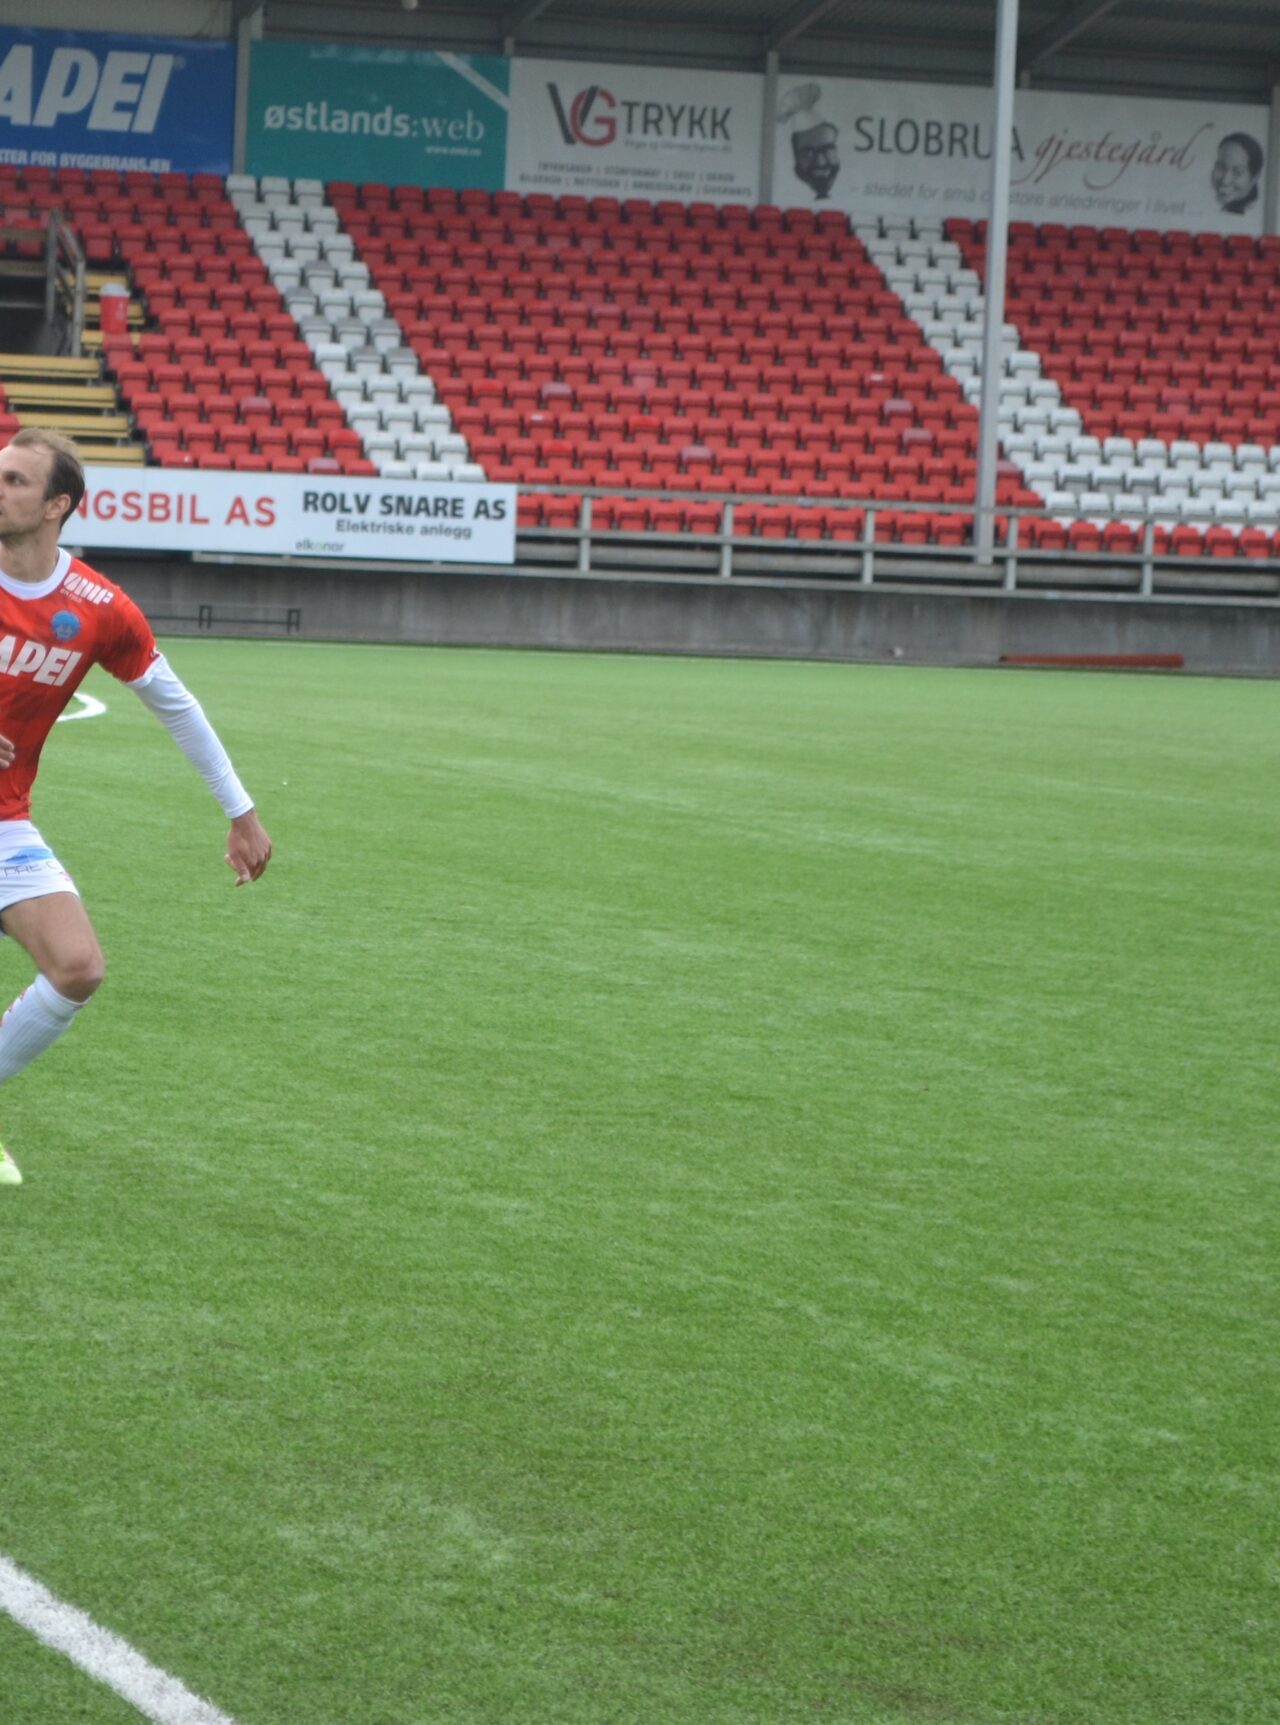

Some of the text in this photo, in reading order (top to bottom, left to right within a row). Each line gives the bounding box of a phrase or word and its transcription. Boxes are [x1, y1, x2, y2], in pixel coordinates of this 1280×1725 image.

[264, 100, 486, 144] østlands:web
[547, 81, 733, 147] VG TRYKK
[30, 151, 57, 168] FOR
[853, 116, 1214, 190] SLOBRUA gjestegård
[224, 496, 277, 528] AS
[303, 492, 507, 521] ROLV SNARE AS
[336, 519, 472, 540] Elektriske anlegg
